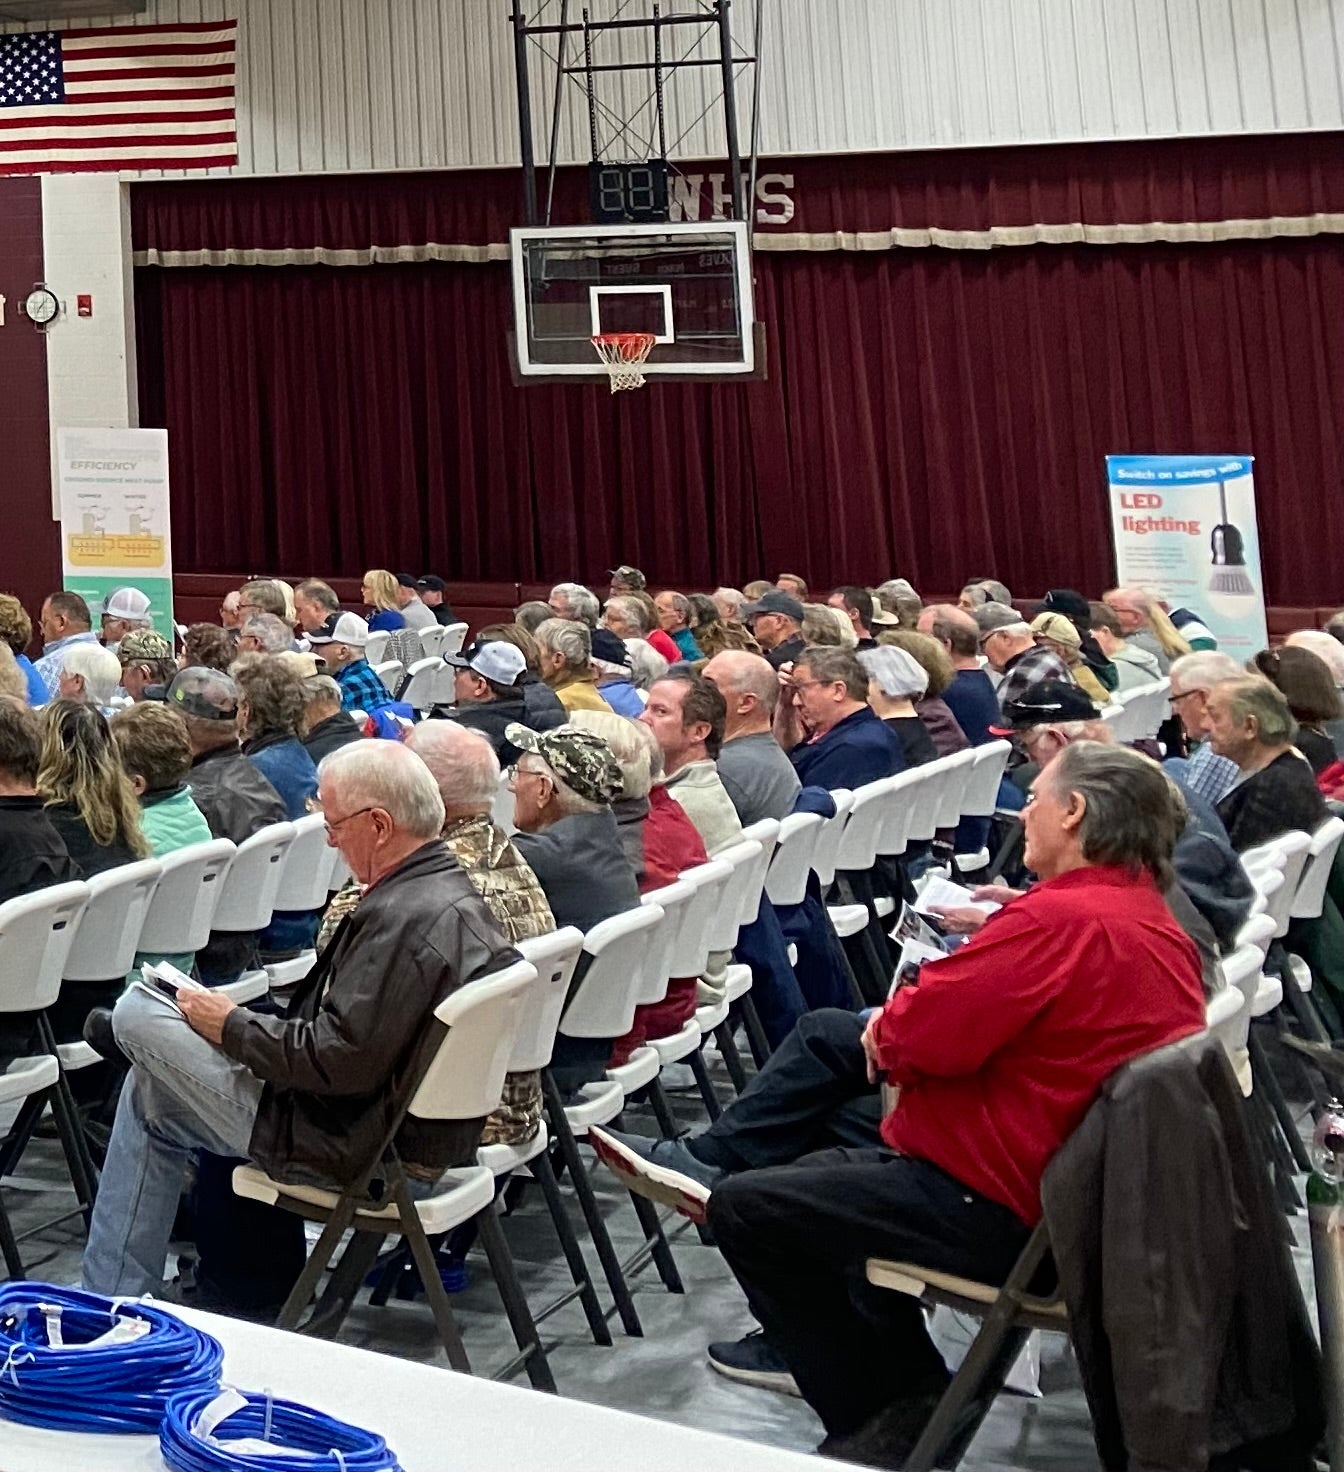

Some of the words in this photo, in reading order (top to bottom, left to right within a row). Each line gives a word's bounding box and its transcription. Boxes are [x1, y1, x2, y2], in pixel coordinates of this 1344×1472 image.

[70, 461, 137, 471] EFFICIENCY
[1117, 469, 1155, 479] Switch
[1176, 468, 1216, 479] savings
[1218, 462, 1242, 473] with
[1120, 493, 1163, 509] LED
[1122, 516, 1201, 535] lighting
